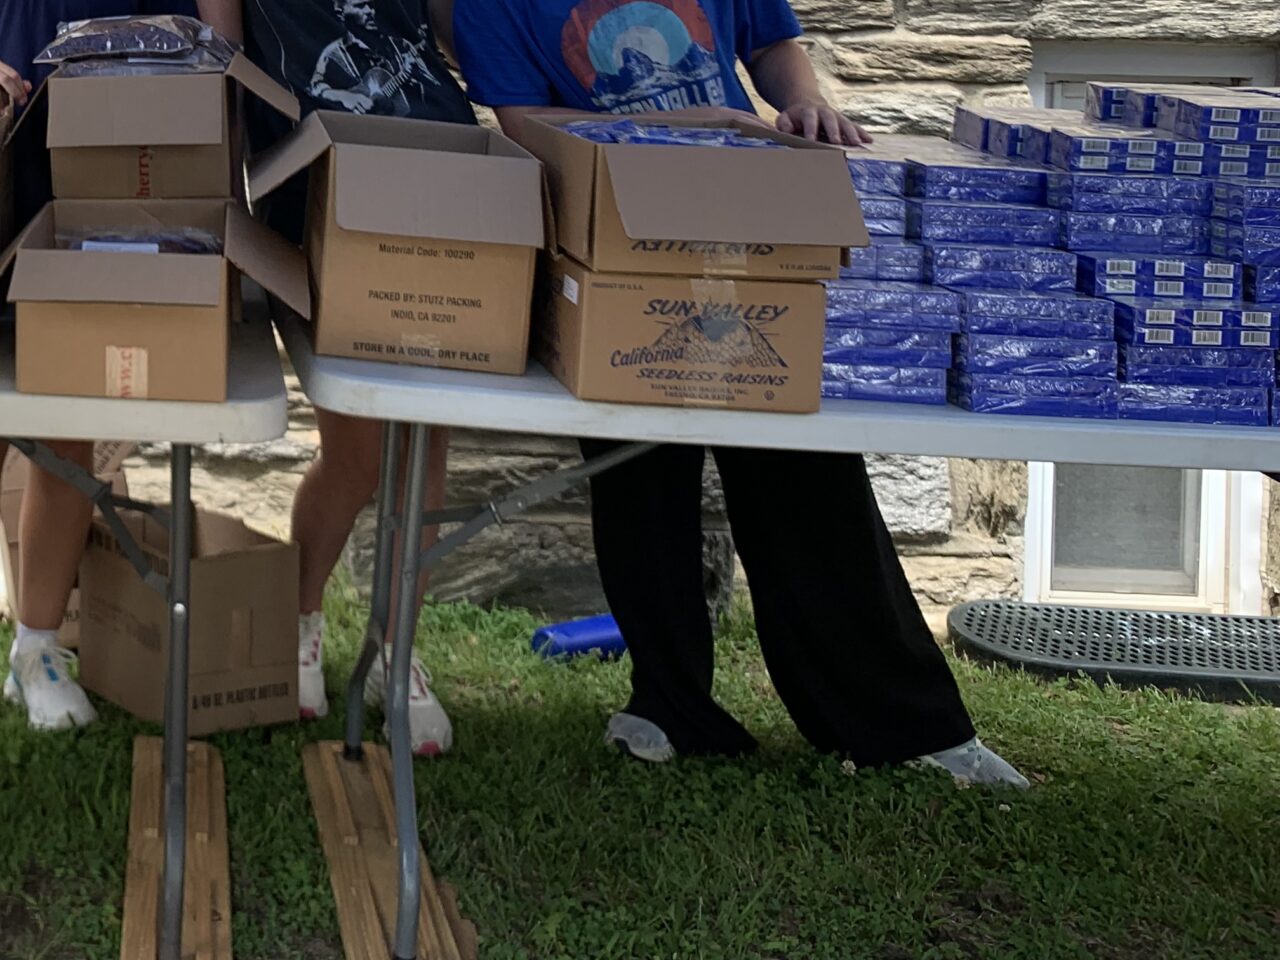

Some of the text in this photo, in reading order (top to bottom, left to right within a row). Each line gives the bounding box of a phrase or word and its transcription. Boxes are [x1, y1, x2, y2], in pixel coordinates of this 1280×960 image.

[378, 243, 475, 260] Material Code: 100290
[368, 289, 482, 308] PACKED BY: STUTZ PACKING
[391, 309, 416, 321] INDIO,
[417, 311, 429, 321] CA
[643, 299, 789, 321] SUN VALLEY
[353, 342, 383, 353] STORE
[386, 344, 396, 353] IN
[398, 345, 405, 355] A
[438, 349, 458, 360] DRY
[460, 351, 490, 362] PLACE
[610, 345, 684, 368] California
[637, 368, 789, 386] SEEDLESS RAISINS
